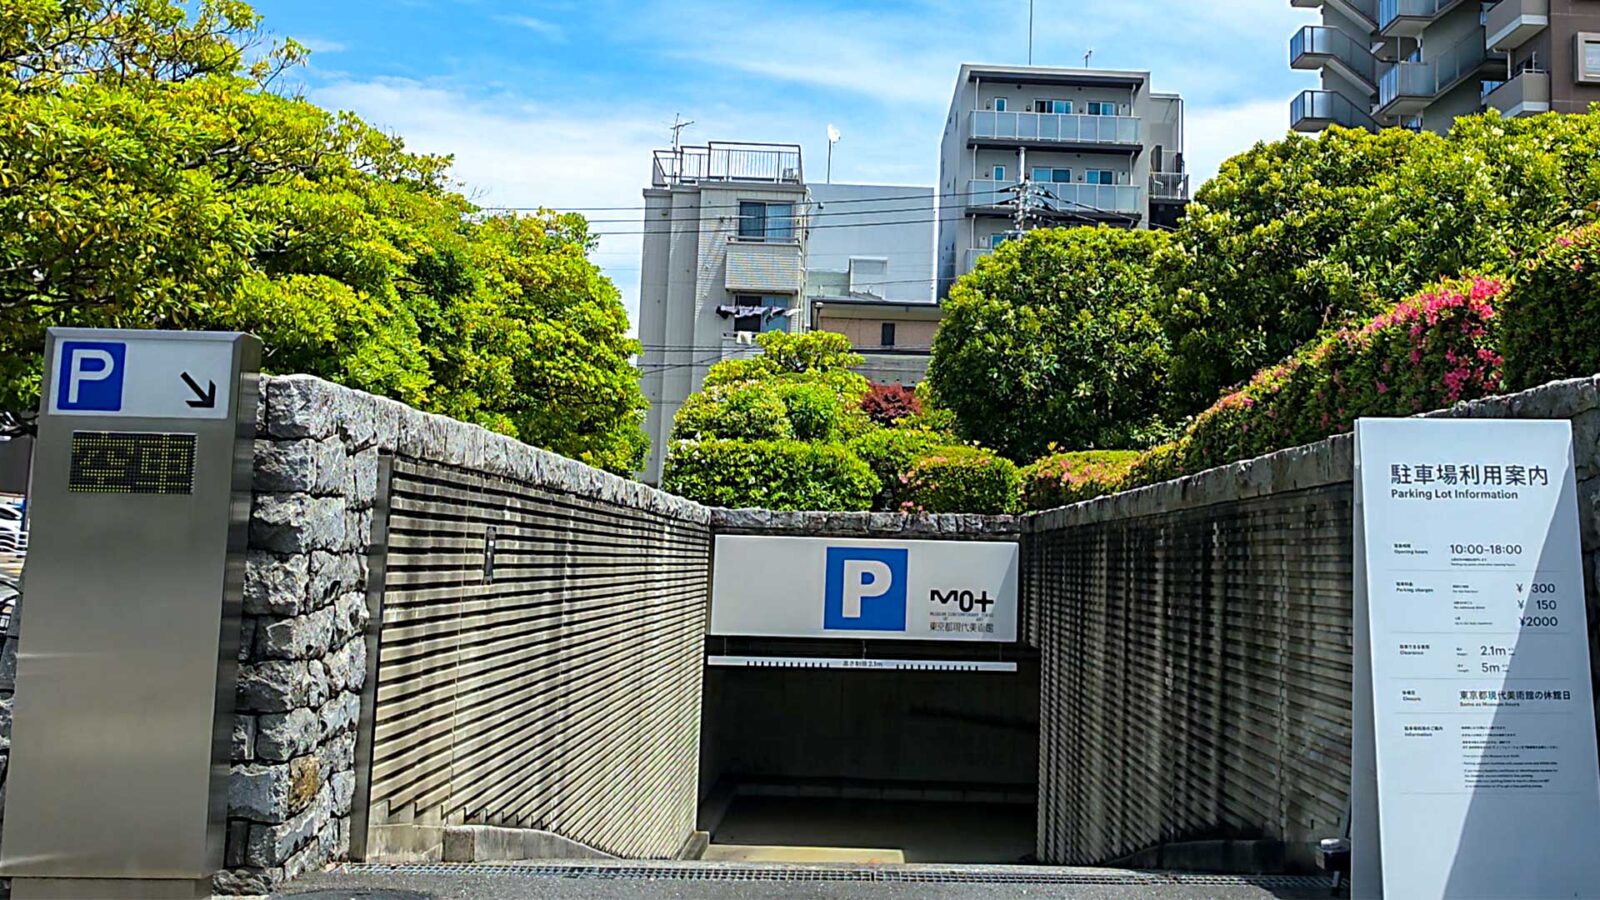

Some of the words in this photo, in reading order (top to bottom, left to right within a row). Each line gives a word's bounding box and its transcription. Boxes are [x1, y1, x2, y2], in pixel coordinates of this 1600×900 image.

[68, 349, 115, 404] P
[69, 432, 193, 493] 空車
[1391, 464, 1548, 486] 駐車場利用案内
[1391, 489, 1432, 500] Parking
[1435, 489, 1452, 499] Lot
[1455, 489, 1518, 500] Information
[842, 560, 892, 618] P
[1531, 583, 1556, 594] 300
[1536, 600, 1557, 610] 150
[1480, 645, 1506, 656] 2.1m
[1481, 662, 1500, 673] 5m
[1459, 690, 1571, 700] 東京都現代美術館の休館日
